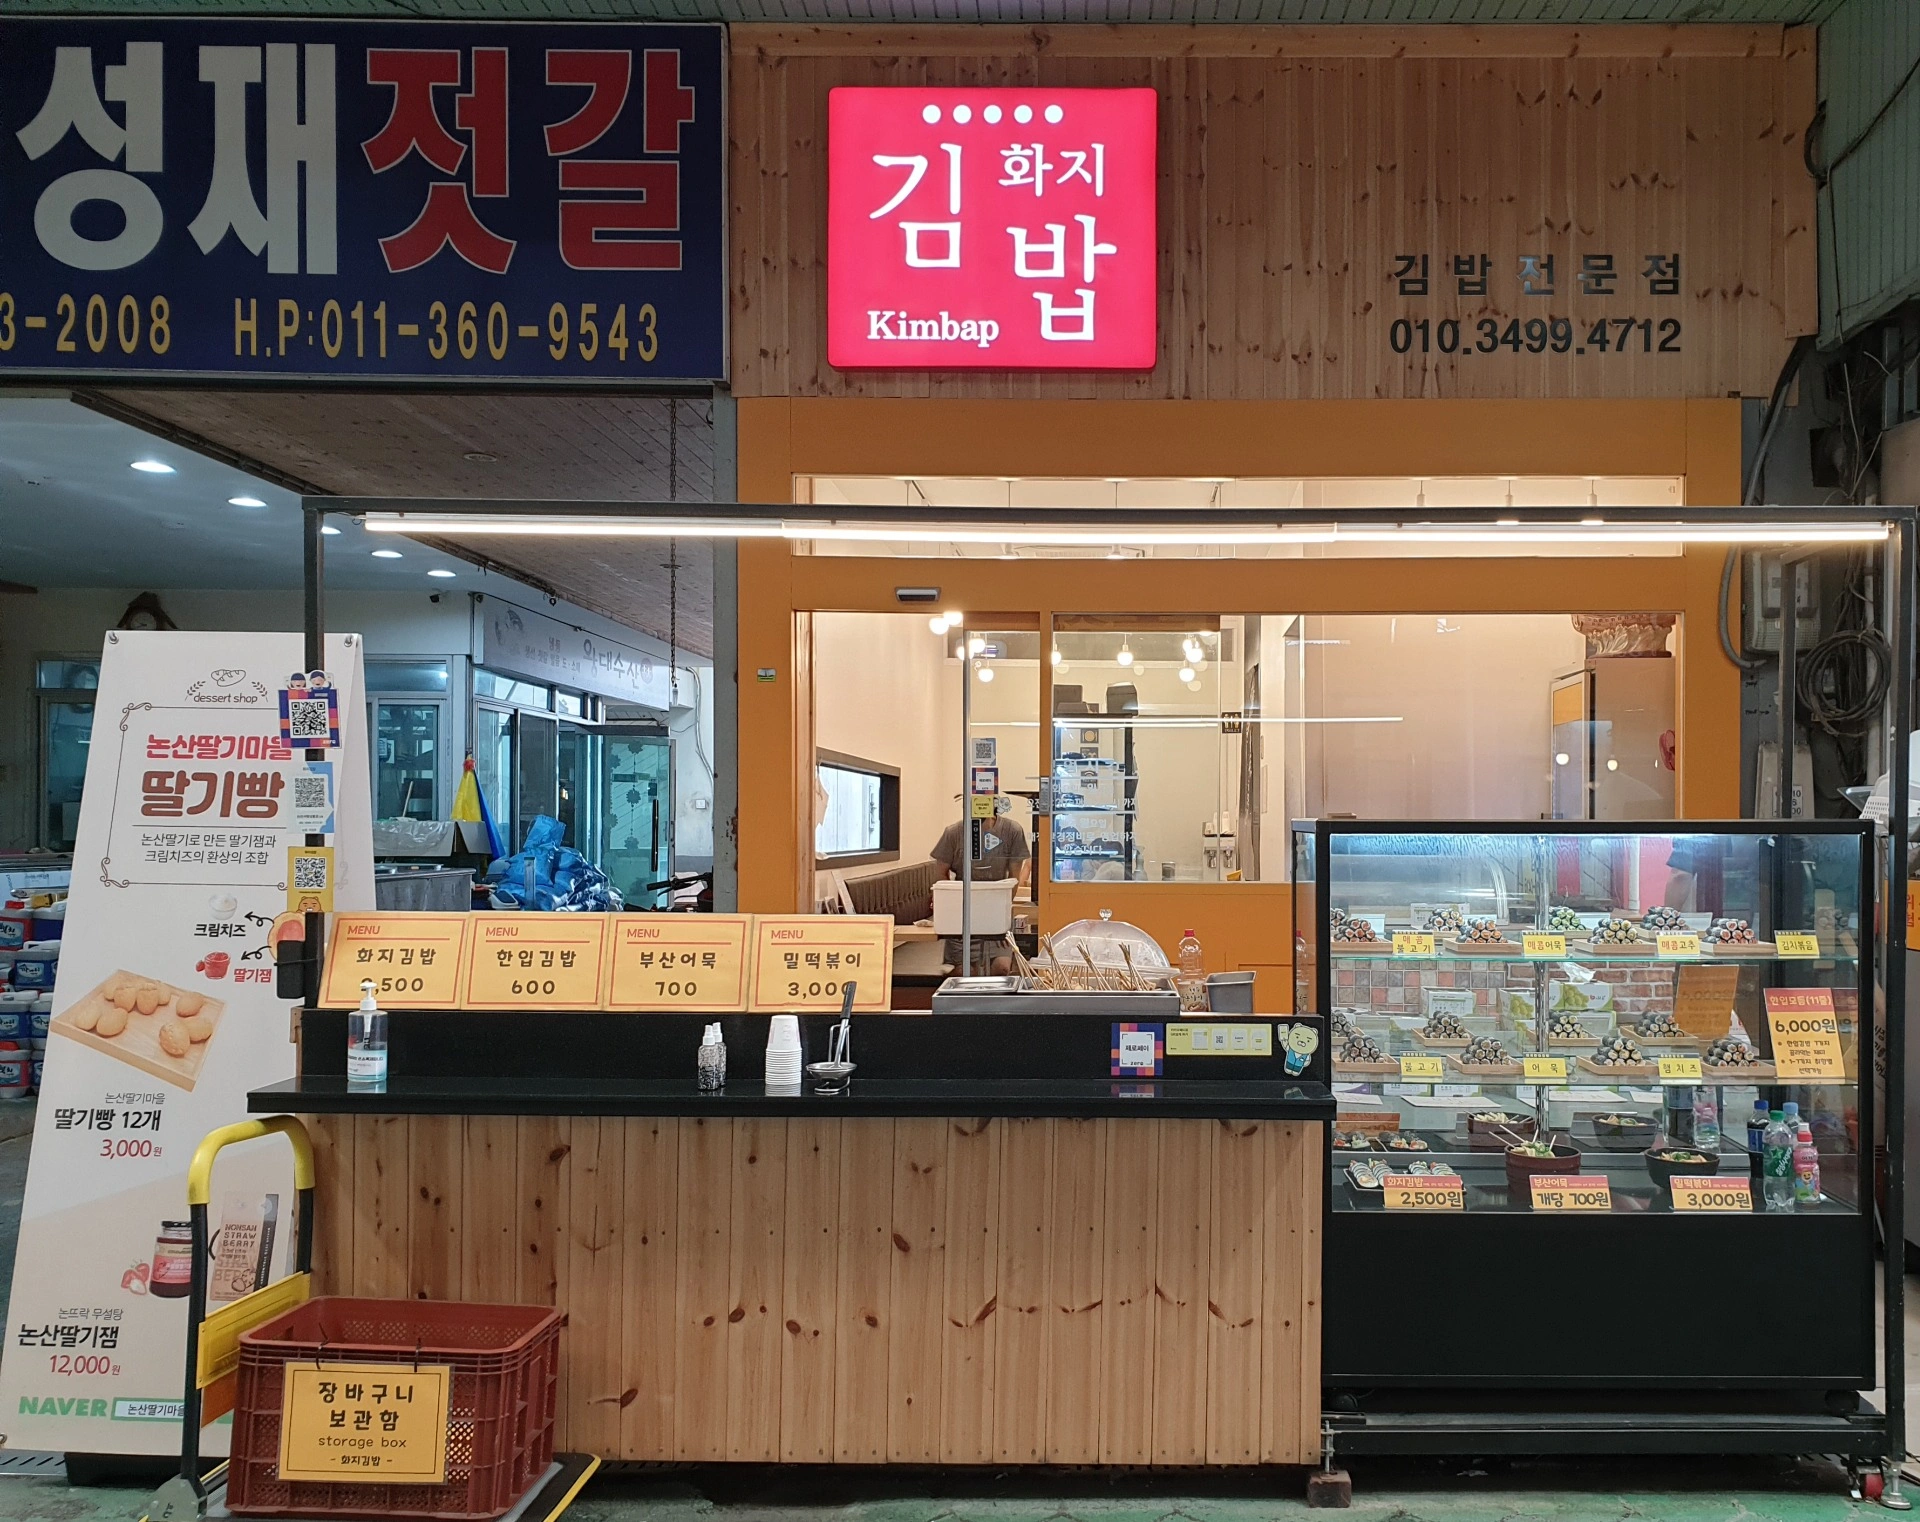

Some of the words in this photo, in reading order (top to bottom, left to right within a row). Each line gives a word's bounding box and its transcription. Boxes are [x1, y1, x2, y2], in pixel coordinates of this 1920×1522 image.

[998, 143, 1105, 197] 화지
[233, 297, 659, 363] H.P:011-360-9543
[866, 311, 1000, 348] Kimbap
[1389, 317, 1682, 356] 010.3499.4712
[193, 692, 231, 704] dessert
[233, 692, 258, 704] shop
[146, 734, 293, 761] 논산딸기마을
[140, 770, 286, 819] 딸기빵
[141, 833, 200, 848] 논산딸기로
[203, 833, 226, 848] 만든
[229, 834, 277, 849] 딸기잼과
[144, 850, 204, 864] 크림치즈의
[206, 850, 242, 865] 환상의
[244, 851, 269, 865] 조합
[194, 923, 247, 938] 크림치즈
[347, 925, 380, 935] MENU
[485, 927, 519, 937] MENU
[626, 928, 660, 938] MENU
[770, 929, 804, 939] MENU
[356, 947, 437, 966] 화지김밥
[496, 950, 577, 968] 한입김밥
[639, 952, 717, 970] 부산어묵
[783, 952, 862, 970] 밀떡볶이
[233, 967, 273, 983] 딸기잼
[511, 980, 556, 995] 600
[654, 981, 698, 996] 700
[1775, 1018, 1836, 1035] 6,000원
[1404, 1061, 1440, 1073] 불고기
[1531, 1062, 1560, 1073] 어묵
[1662, 1063, 1698, 1073] 햄치즈
[105, 1092, 166, 1105] 논산딸기마을
[54, 1108, 117, 1131] 딸기빵
[122, 1109, 162, 1132] 12개
[99, 1138, 162, 1160] 3,000원
[1387, 1177, 1424, 1187] 화지김밥
[1534, 1178, 1568, 1188] 부산어묵
[1674, 1179, 1712, 1189] 밀떡볶이
[1400, 1191, 1462, 1207] 2,500원
[1536, 1192, 1564, 1207] 개당
[1569, 1192, 1609, 1206] 700원
[1687, 1192, 1751, 1209] 3,000원
[223, 1231, 257, 1239] STRAW
[222, 1240, 256, 1248] BERRY
[92, 1308, 124, 1321] 무설탕
[18, 1323, 119, 1349] 논산딸기잼
[49, 1354, 121, 1379] 12,000원
[318, 1382, 413, 1404] 장바구니
[18, 1396, 108, 1418] NAVER
[127, 1404, 184, 1417] 논산딸기마을
[329, 1410, 399, 1431] 보관함
[318, 1436, 374, 1449] storage
[381, 1437, 407, 1448] box
[341, 1455, 381, 1467] 화지김밥
